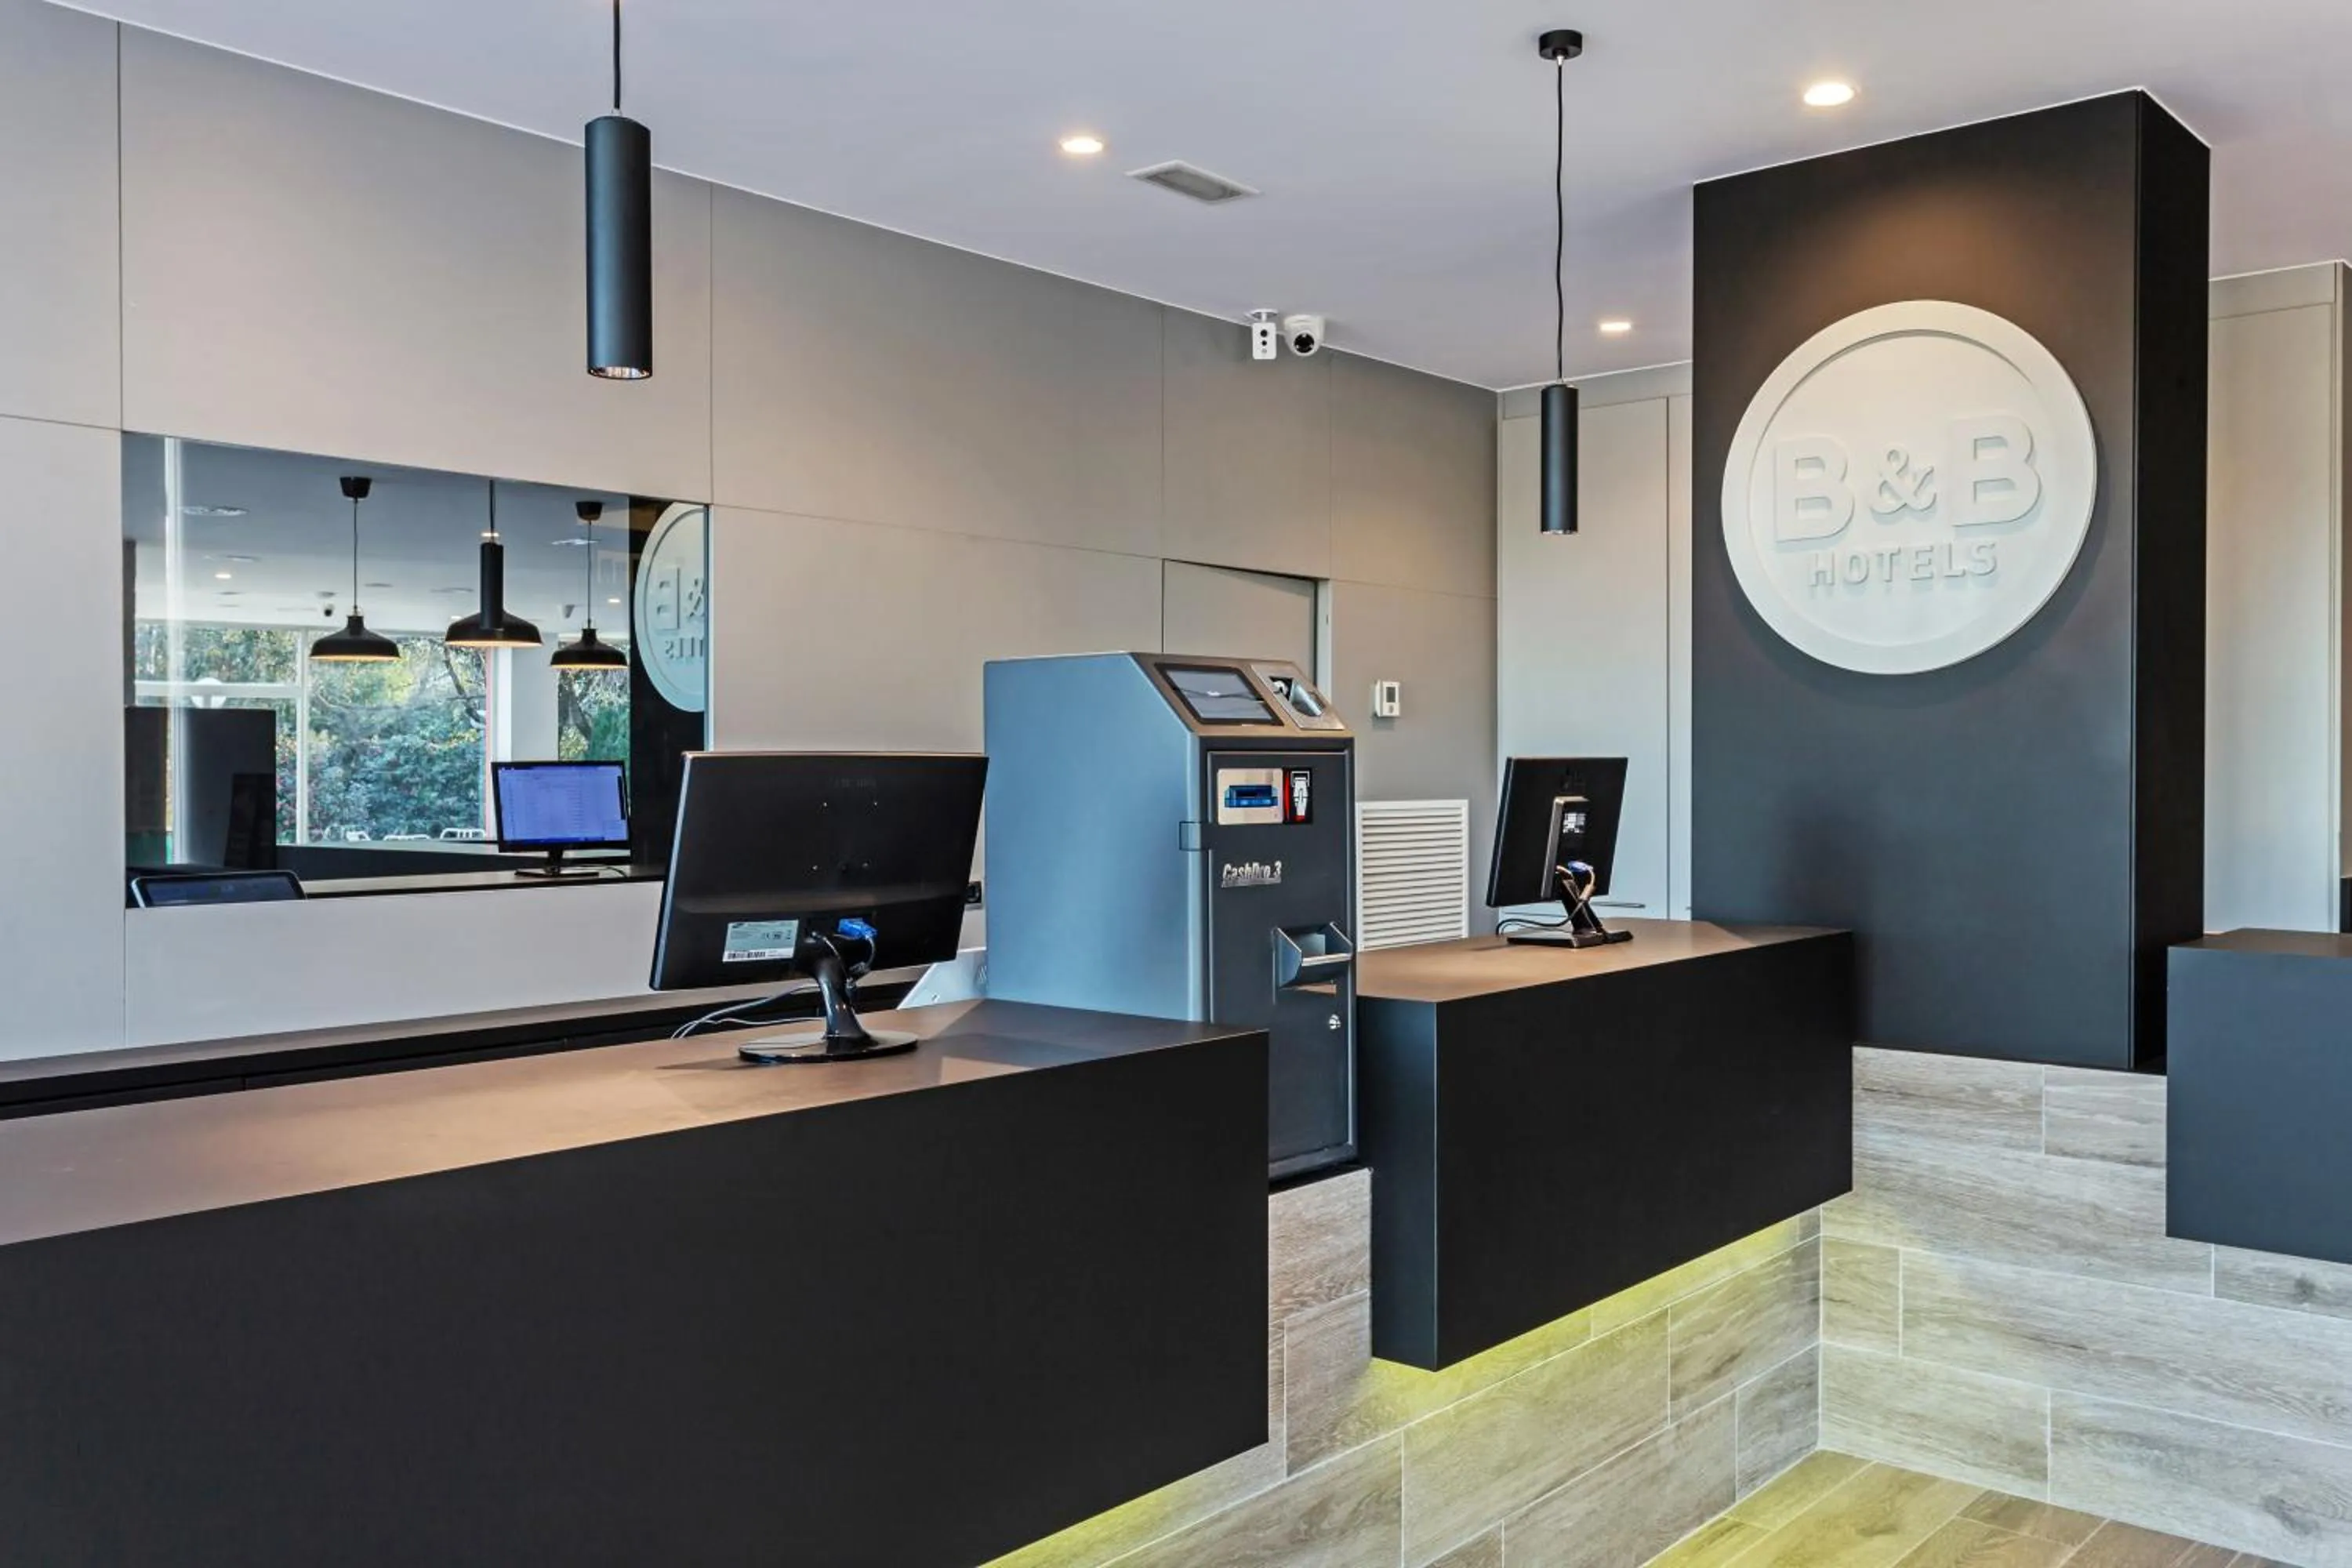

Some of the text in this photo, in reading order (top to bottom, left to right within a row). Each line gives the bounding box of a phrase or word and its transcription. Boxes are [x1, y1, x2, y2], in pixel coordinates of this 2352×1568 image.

[1775, 418, 2042, 542] B&B
[1809, 543, 1998, 588] HOTELS
[1273, 860, 1282, 879] 3
